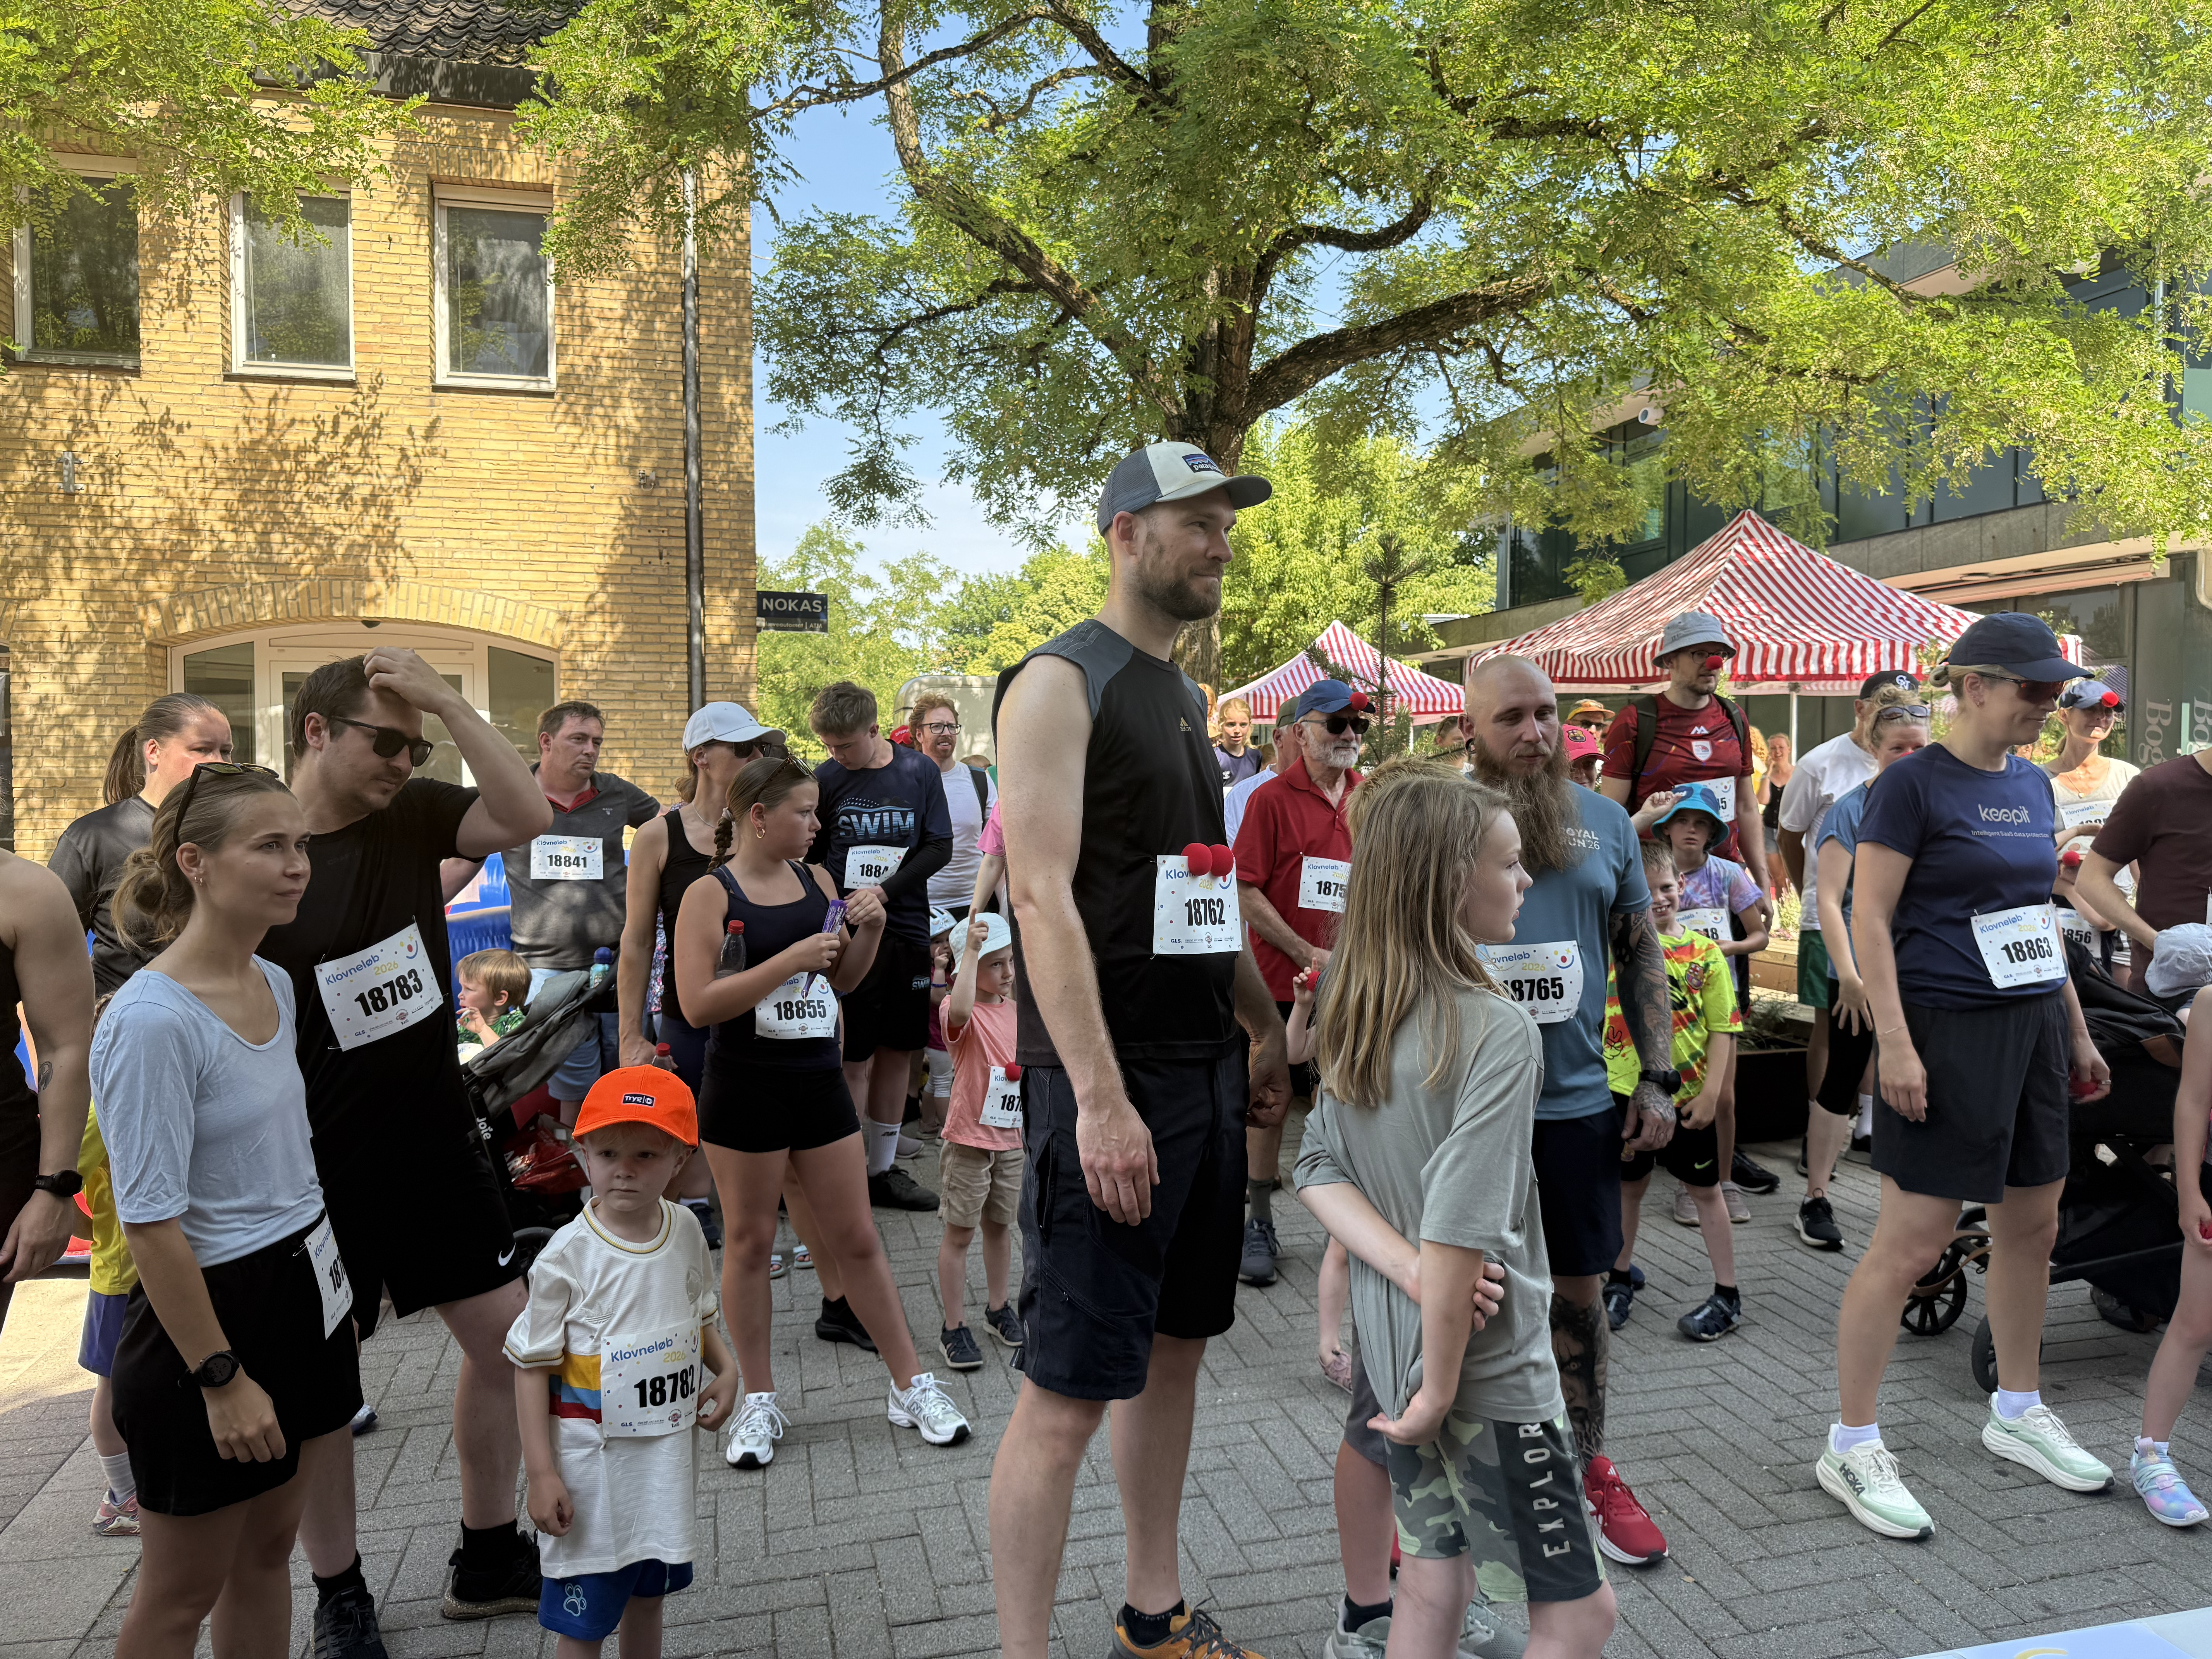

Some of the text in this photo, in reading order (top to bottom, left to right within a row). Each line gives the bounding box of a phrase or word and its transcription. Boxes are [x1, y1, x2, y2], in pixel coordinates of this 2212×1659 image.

[763, 598, 822, 613] NOKAS
[2138, 698, 2172, 766] Bog
[1978, 804, 2030, 826] keepit
[838, 812, 915, 840] SWIM
[1561, 828, 1599, 840] OYAL
[547, 854, 587, 868] 18841
[859, 864, 889, 878] 188
[1199, 878, 1213, 890] 2026
[1316, 880, 1347, 898] 1875
[1185, 898, 1225, 926] 18762
[1979, 914, 2023, 934] Klovneløb
[1492, 951, 1530, 963] ovneløb
[2001, 936, 2053, 963] 18863
[325, 955, 380, 985] Klovneløb
[373, 961, 398, 975] 2026
[1522, 963, 1546, 971] 2026
[354, 969, 423, 1017] 18783
[774, 1000, 827, 1021] 18855
[1001, 1094, 1023, 1112] 187
[476, 1117, 493, 1140] Joie
[329, 1252, 346, 1295] 187
[611, 1337, 673, 1362] Klovneløb
[663, 1351, 686, 1363] 2026
[634, 1364, 696, 1408] 18782
[1518, 1422, 1571, 1558] EXPLOR
[1839, 1462, 1865, 1498] HOKA
